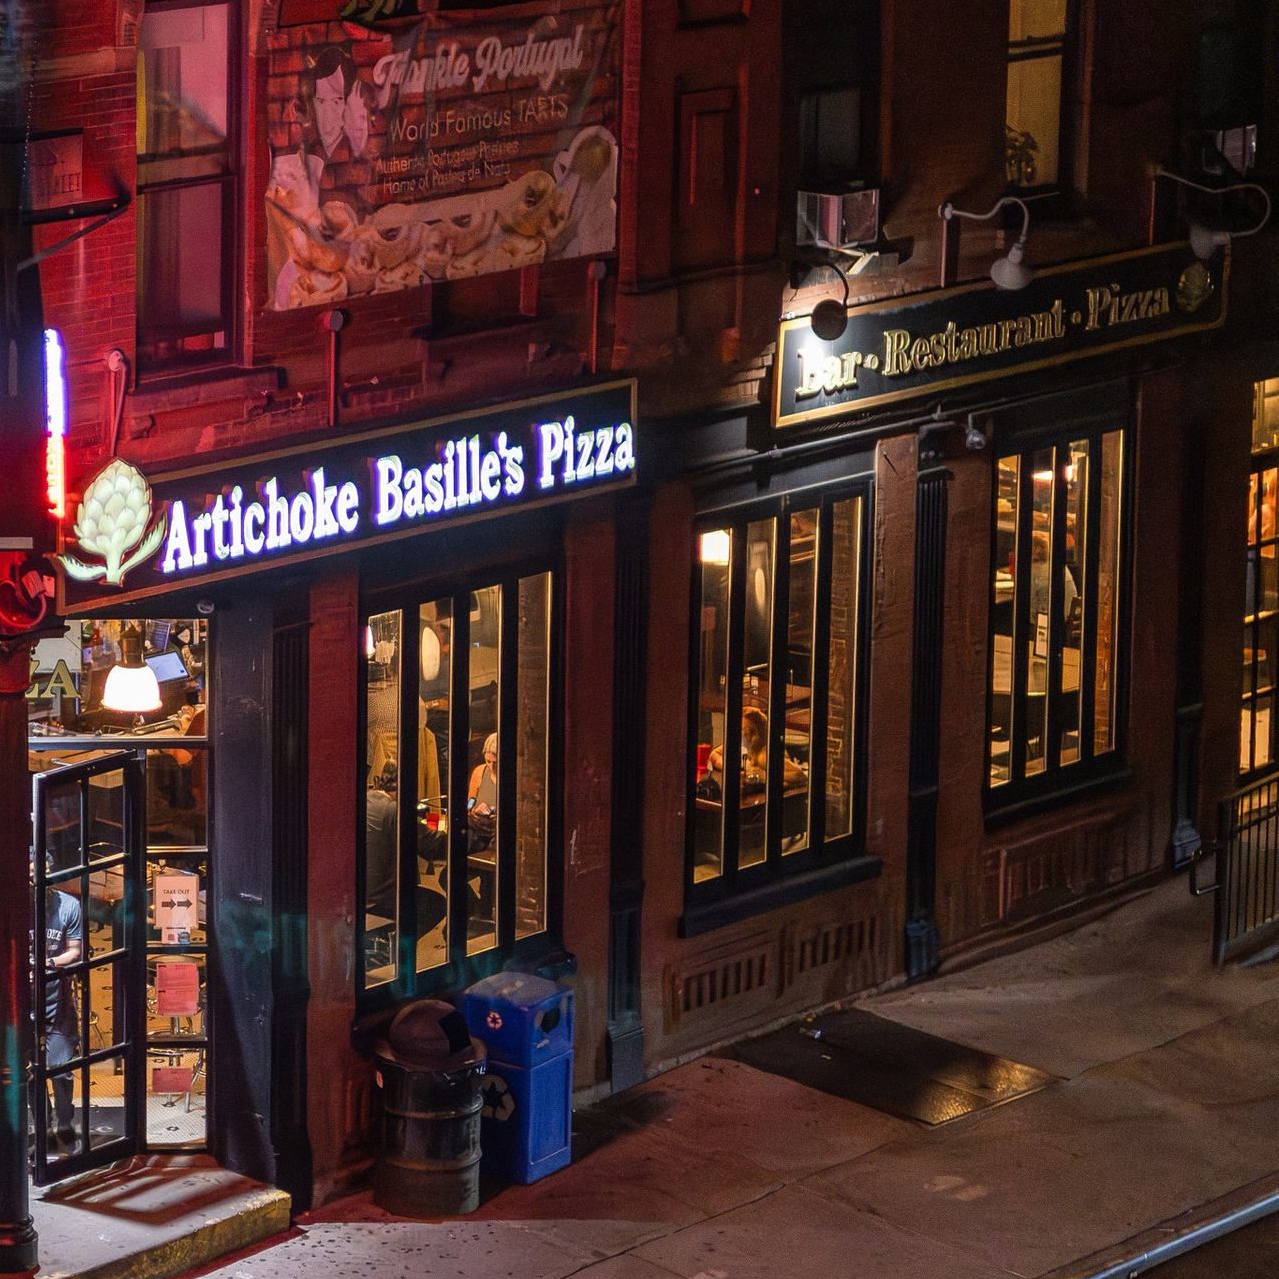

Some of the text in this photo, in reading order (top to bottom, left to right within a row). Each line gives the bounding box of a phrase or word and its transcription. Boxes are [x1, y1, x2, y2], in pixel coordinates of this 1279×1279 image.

[472, 24, 584, 92] Portugal
[390, 93, 569, 142] World Famous TARTS
[794, 282, 1170, 397] Bar Restaurant Pizza
[160, 415, 636, 573] Artichoke Basille's Pizza
